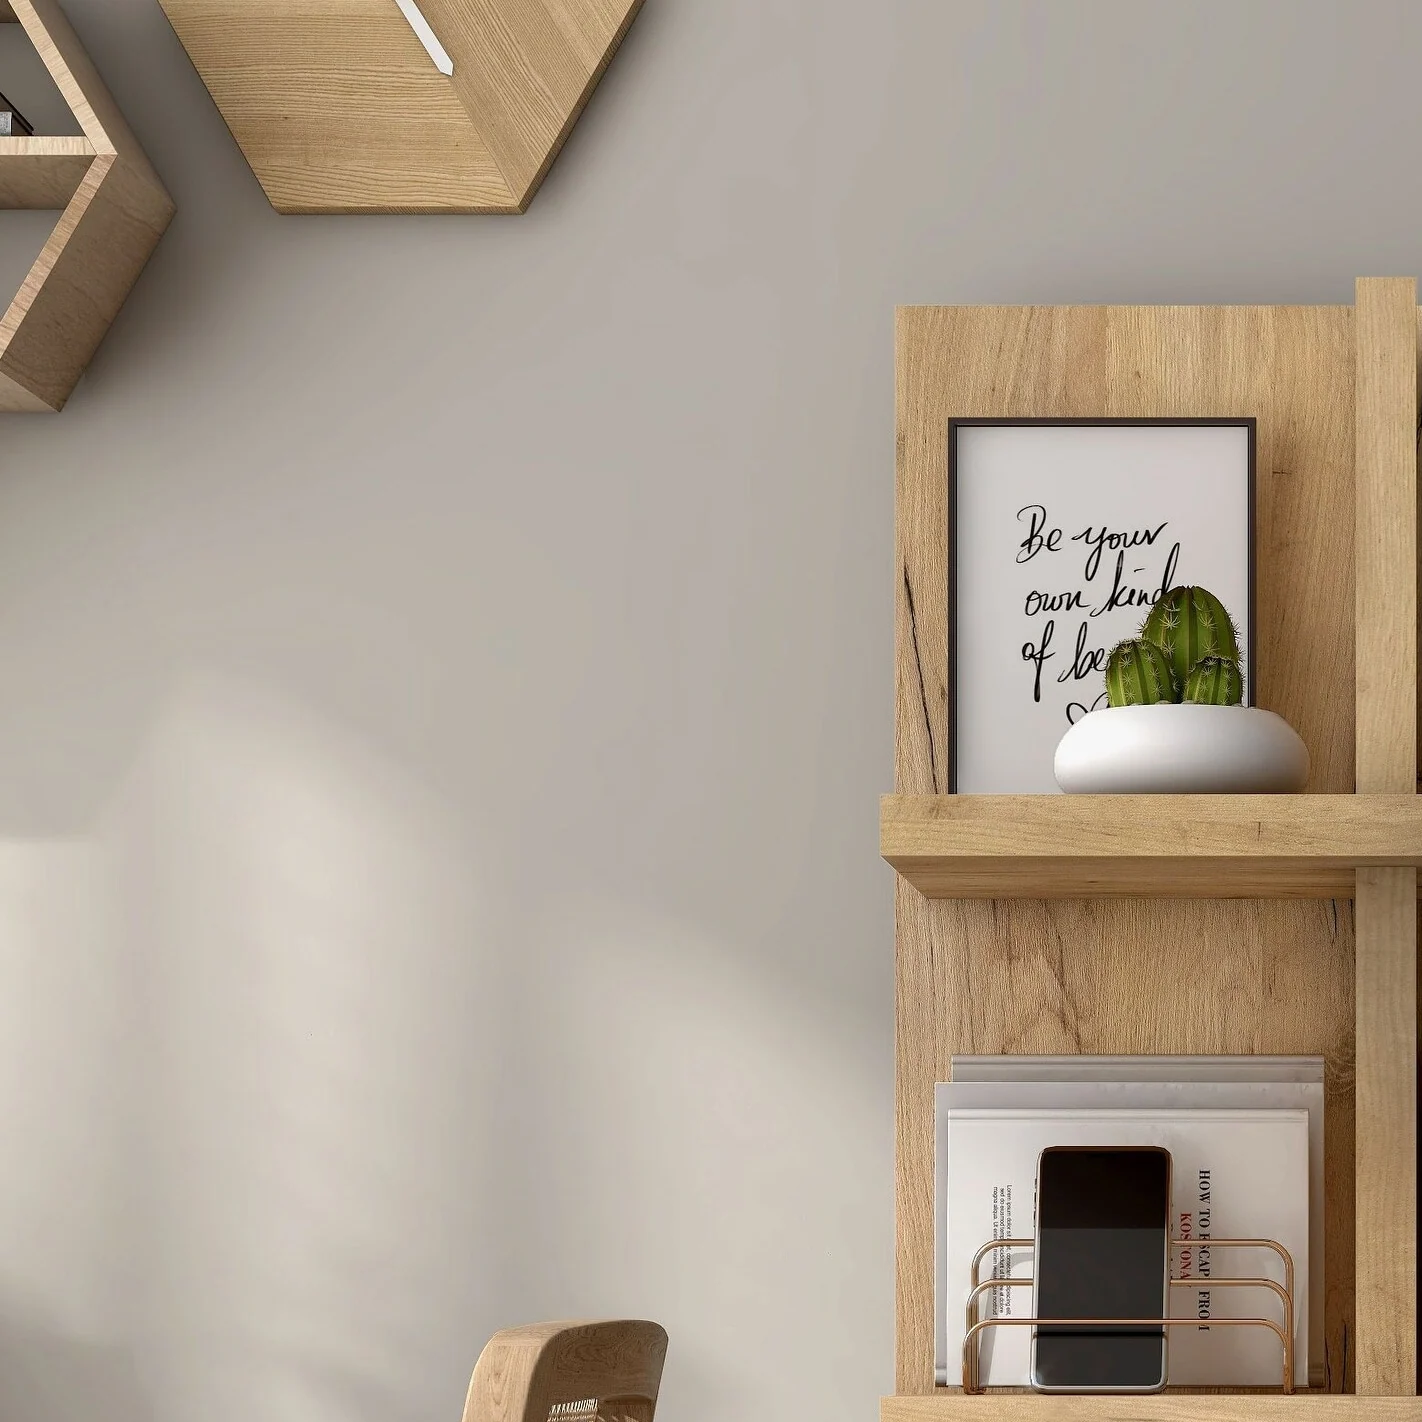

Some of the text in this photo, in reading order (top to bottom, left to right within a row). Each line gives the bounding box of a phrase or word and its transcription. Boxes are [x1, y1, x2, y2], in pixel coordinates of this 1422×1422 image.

[1016, 504, 1168, 581] Be your
[1025, 542, 1180, 618] own kind
[1021, 620, 1056, 703] of
[1198, 1169, 1211, 1204] HOW
[1198, 1208, 1211, 1229] TO
[1198, 1233, 1211, 1283] ESCAP
